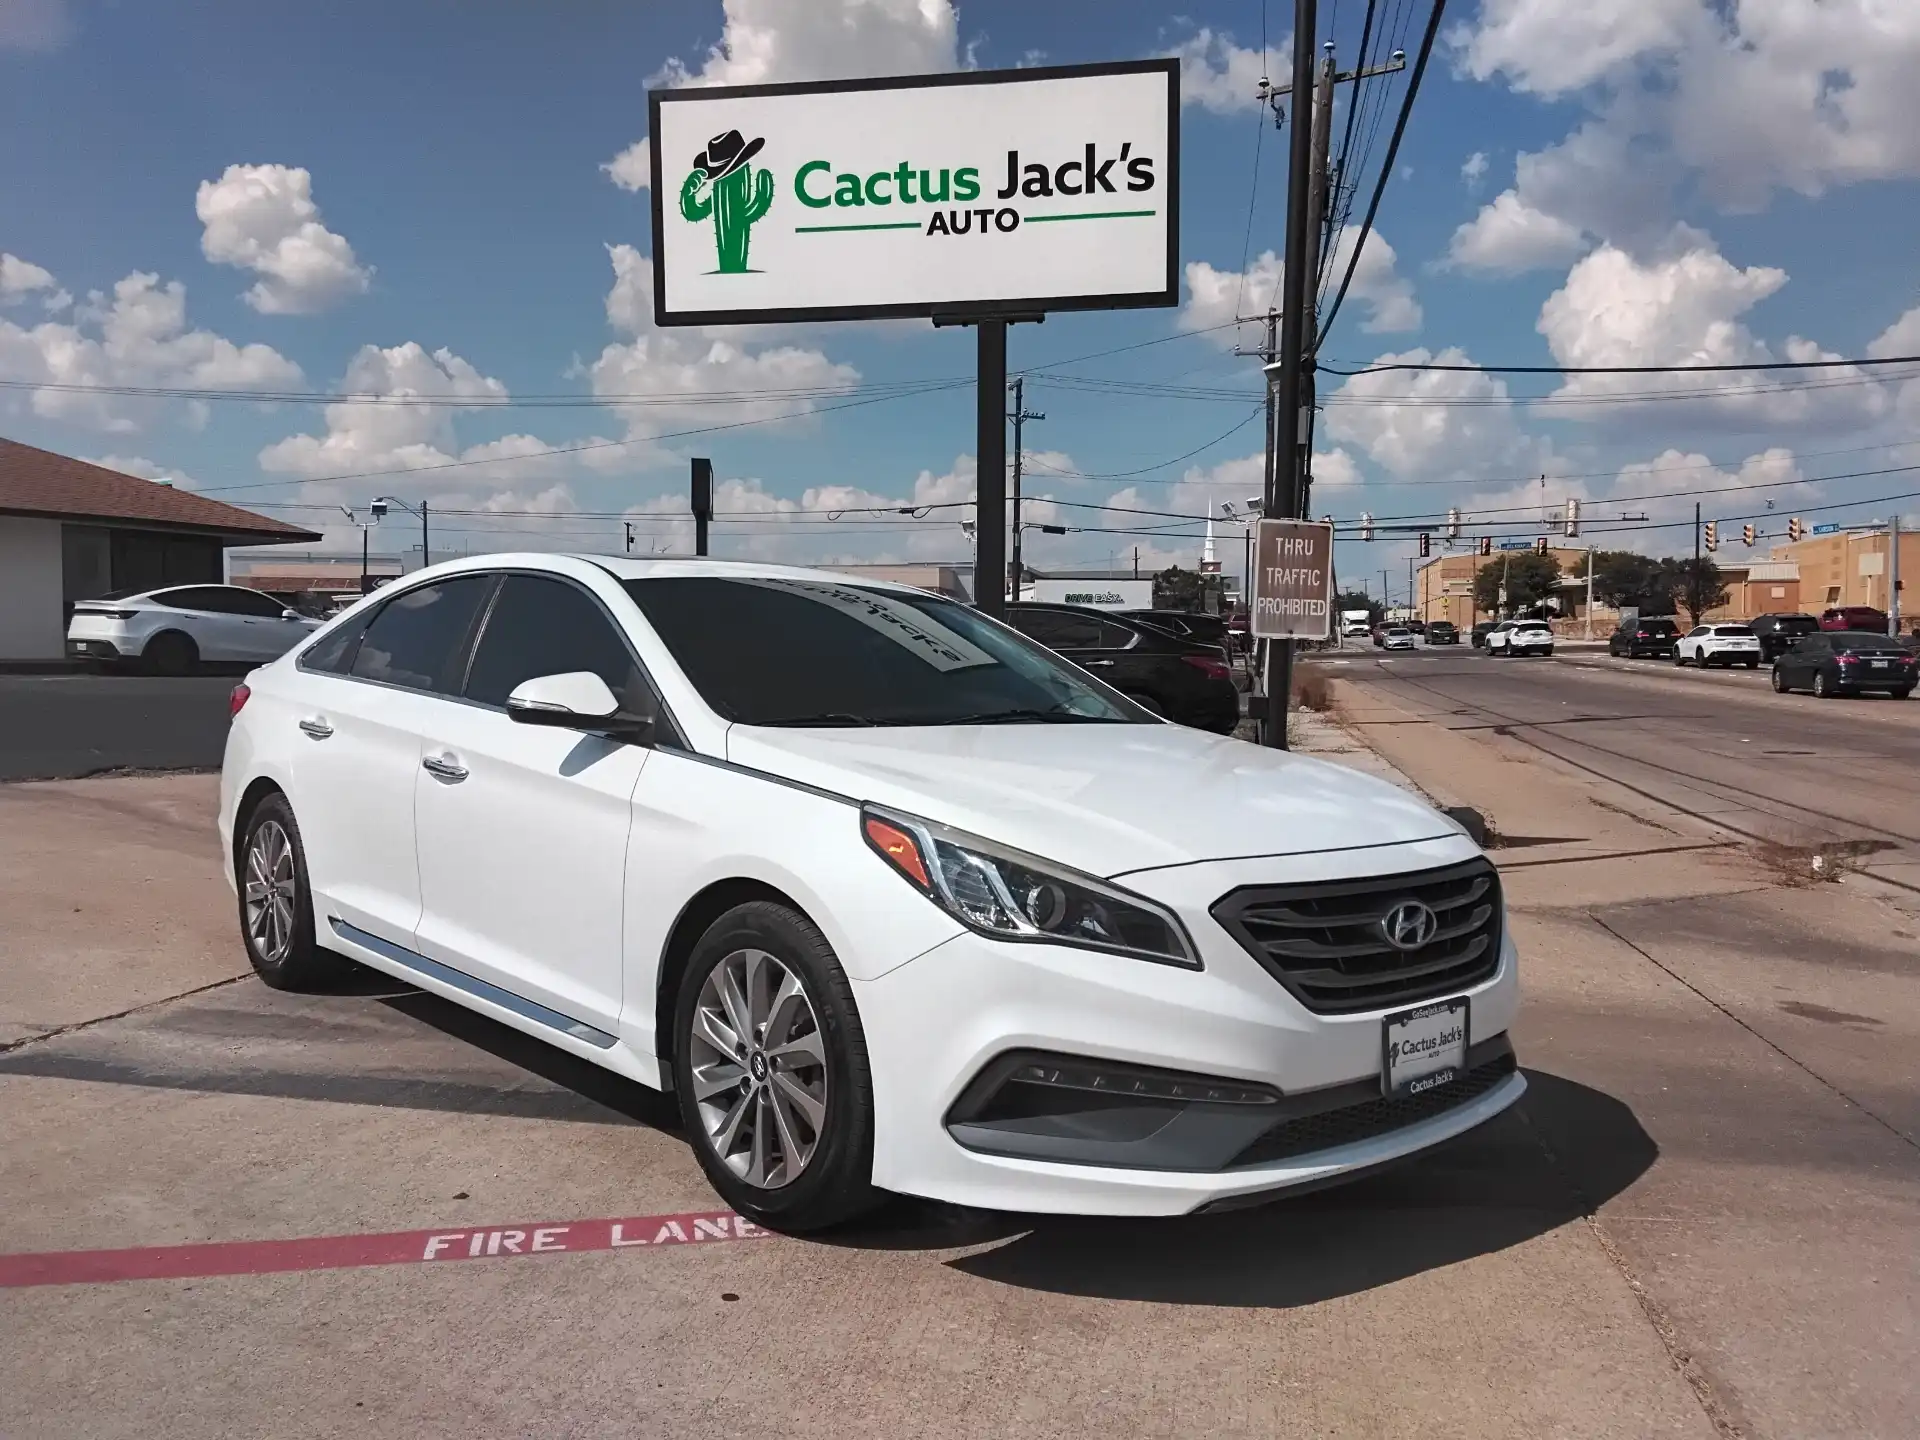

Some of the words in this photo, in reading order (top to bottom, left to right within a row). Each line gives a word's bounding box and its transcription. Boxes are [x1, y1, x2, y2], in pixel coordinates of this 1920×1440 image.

[794, 159, 981, 208] Cactus
[997, 143, 1155, 199] Jack's
[926, 207, 1020, 236] AUTO
[1275, 538, 1314, 556] THRU
[1266, 567, 1320, 586] TRAFFIC
[1065, 593, 1093, 602] DRIVE
[1257, 597, 1326, 616] PROHIBITED
[1402, 1037, 1437, 1056] Cactus
[1438, 1025, 1462, 1047] Jack's
[1428, 1050, 1440, 1059] AUTO
[1410, 1078, 1434, 1093] Cactus
[1435, 1070, 1453, 1086] Jack's
[423, 1227, 570, 1260] FIRE
[611, 1215, 770, 1247] LANE
